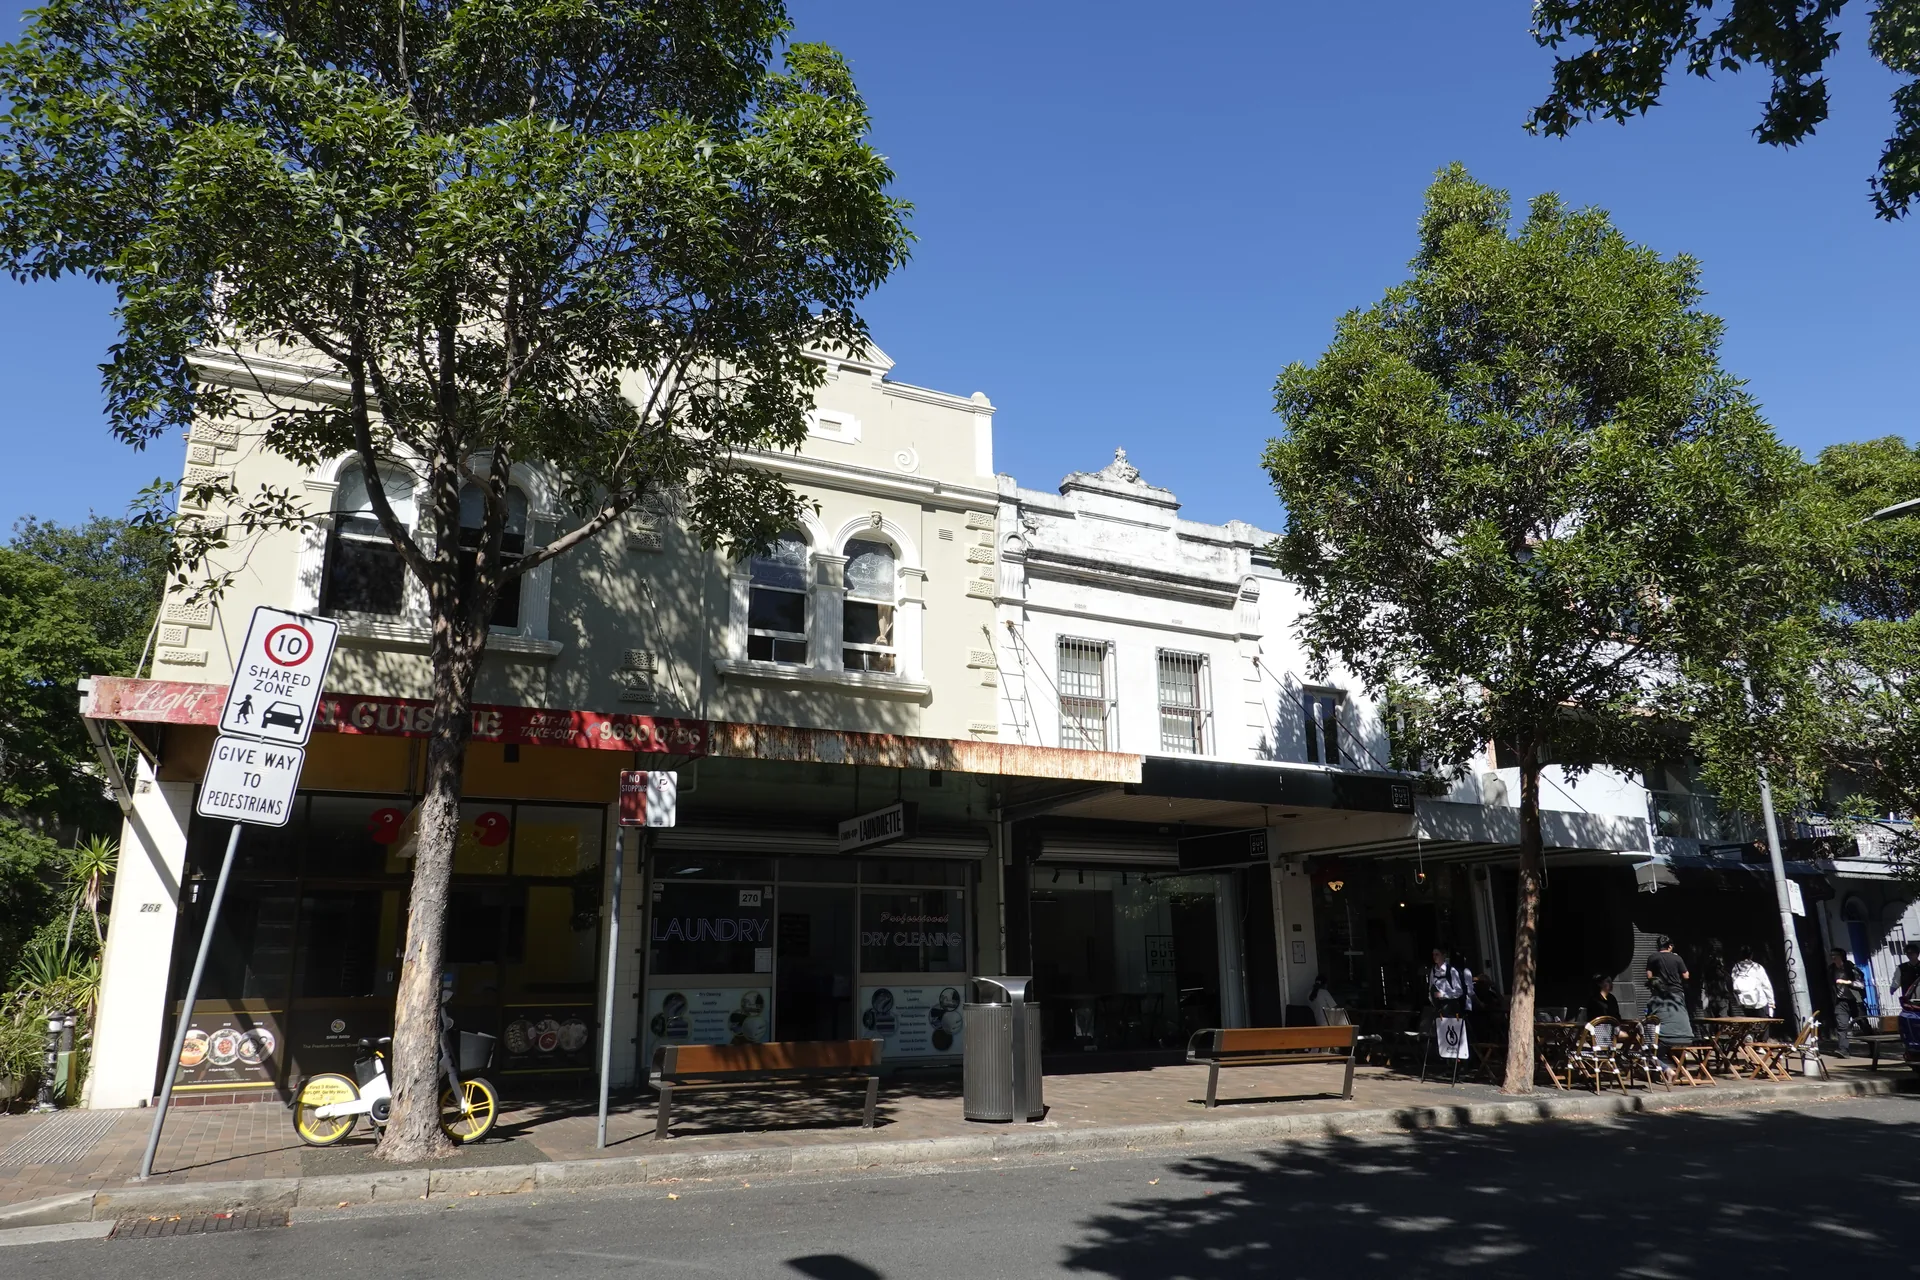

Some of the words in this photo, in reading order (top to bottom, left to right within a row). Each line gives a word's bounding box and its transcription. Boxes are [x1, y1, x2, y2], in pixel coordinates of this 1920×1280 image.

[278, 634, 302, 655] 10
[249, 665, 311, 687] SHARED
[253, 679, 295, 698] ZONE
[351, 701, 504, 736] CUISE
[530, 714, 574, 727] EAT-IN
[520, 726, 579, 740] TAKE-OUT
[600, 721, 650, 742] 9690
[218, 746, 257, 765] GIVE
[264, 752, 296, 770] WAY
[243, 772, 261, 788] TO
[629, 774, 640, 783] NO
[621, 784, 647, 792] STOPPING
[207, 791, 283, 815] PEDESTRIANS
[860, 810, 901, 841] LAUNDRETTE
[742, 894, 758, 903] 270
[140, 903, 161, 913] 268
[880, 911, 949, 925] Professional
[652, 917, 769, 942] LAUNDRY
[861, 931, 890, 947] DRY
[893, 931, 962, 947] CLEANING
[1150, 941, 1176, 949] THE
[1151, 950, 1175, 958] OUT
[1152, 959, 1176, 967] FIT
